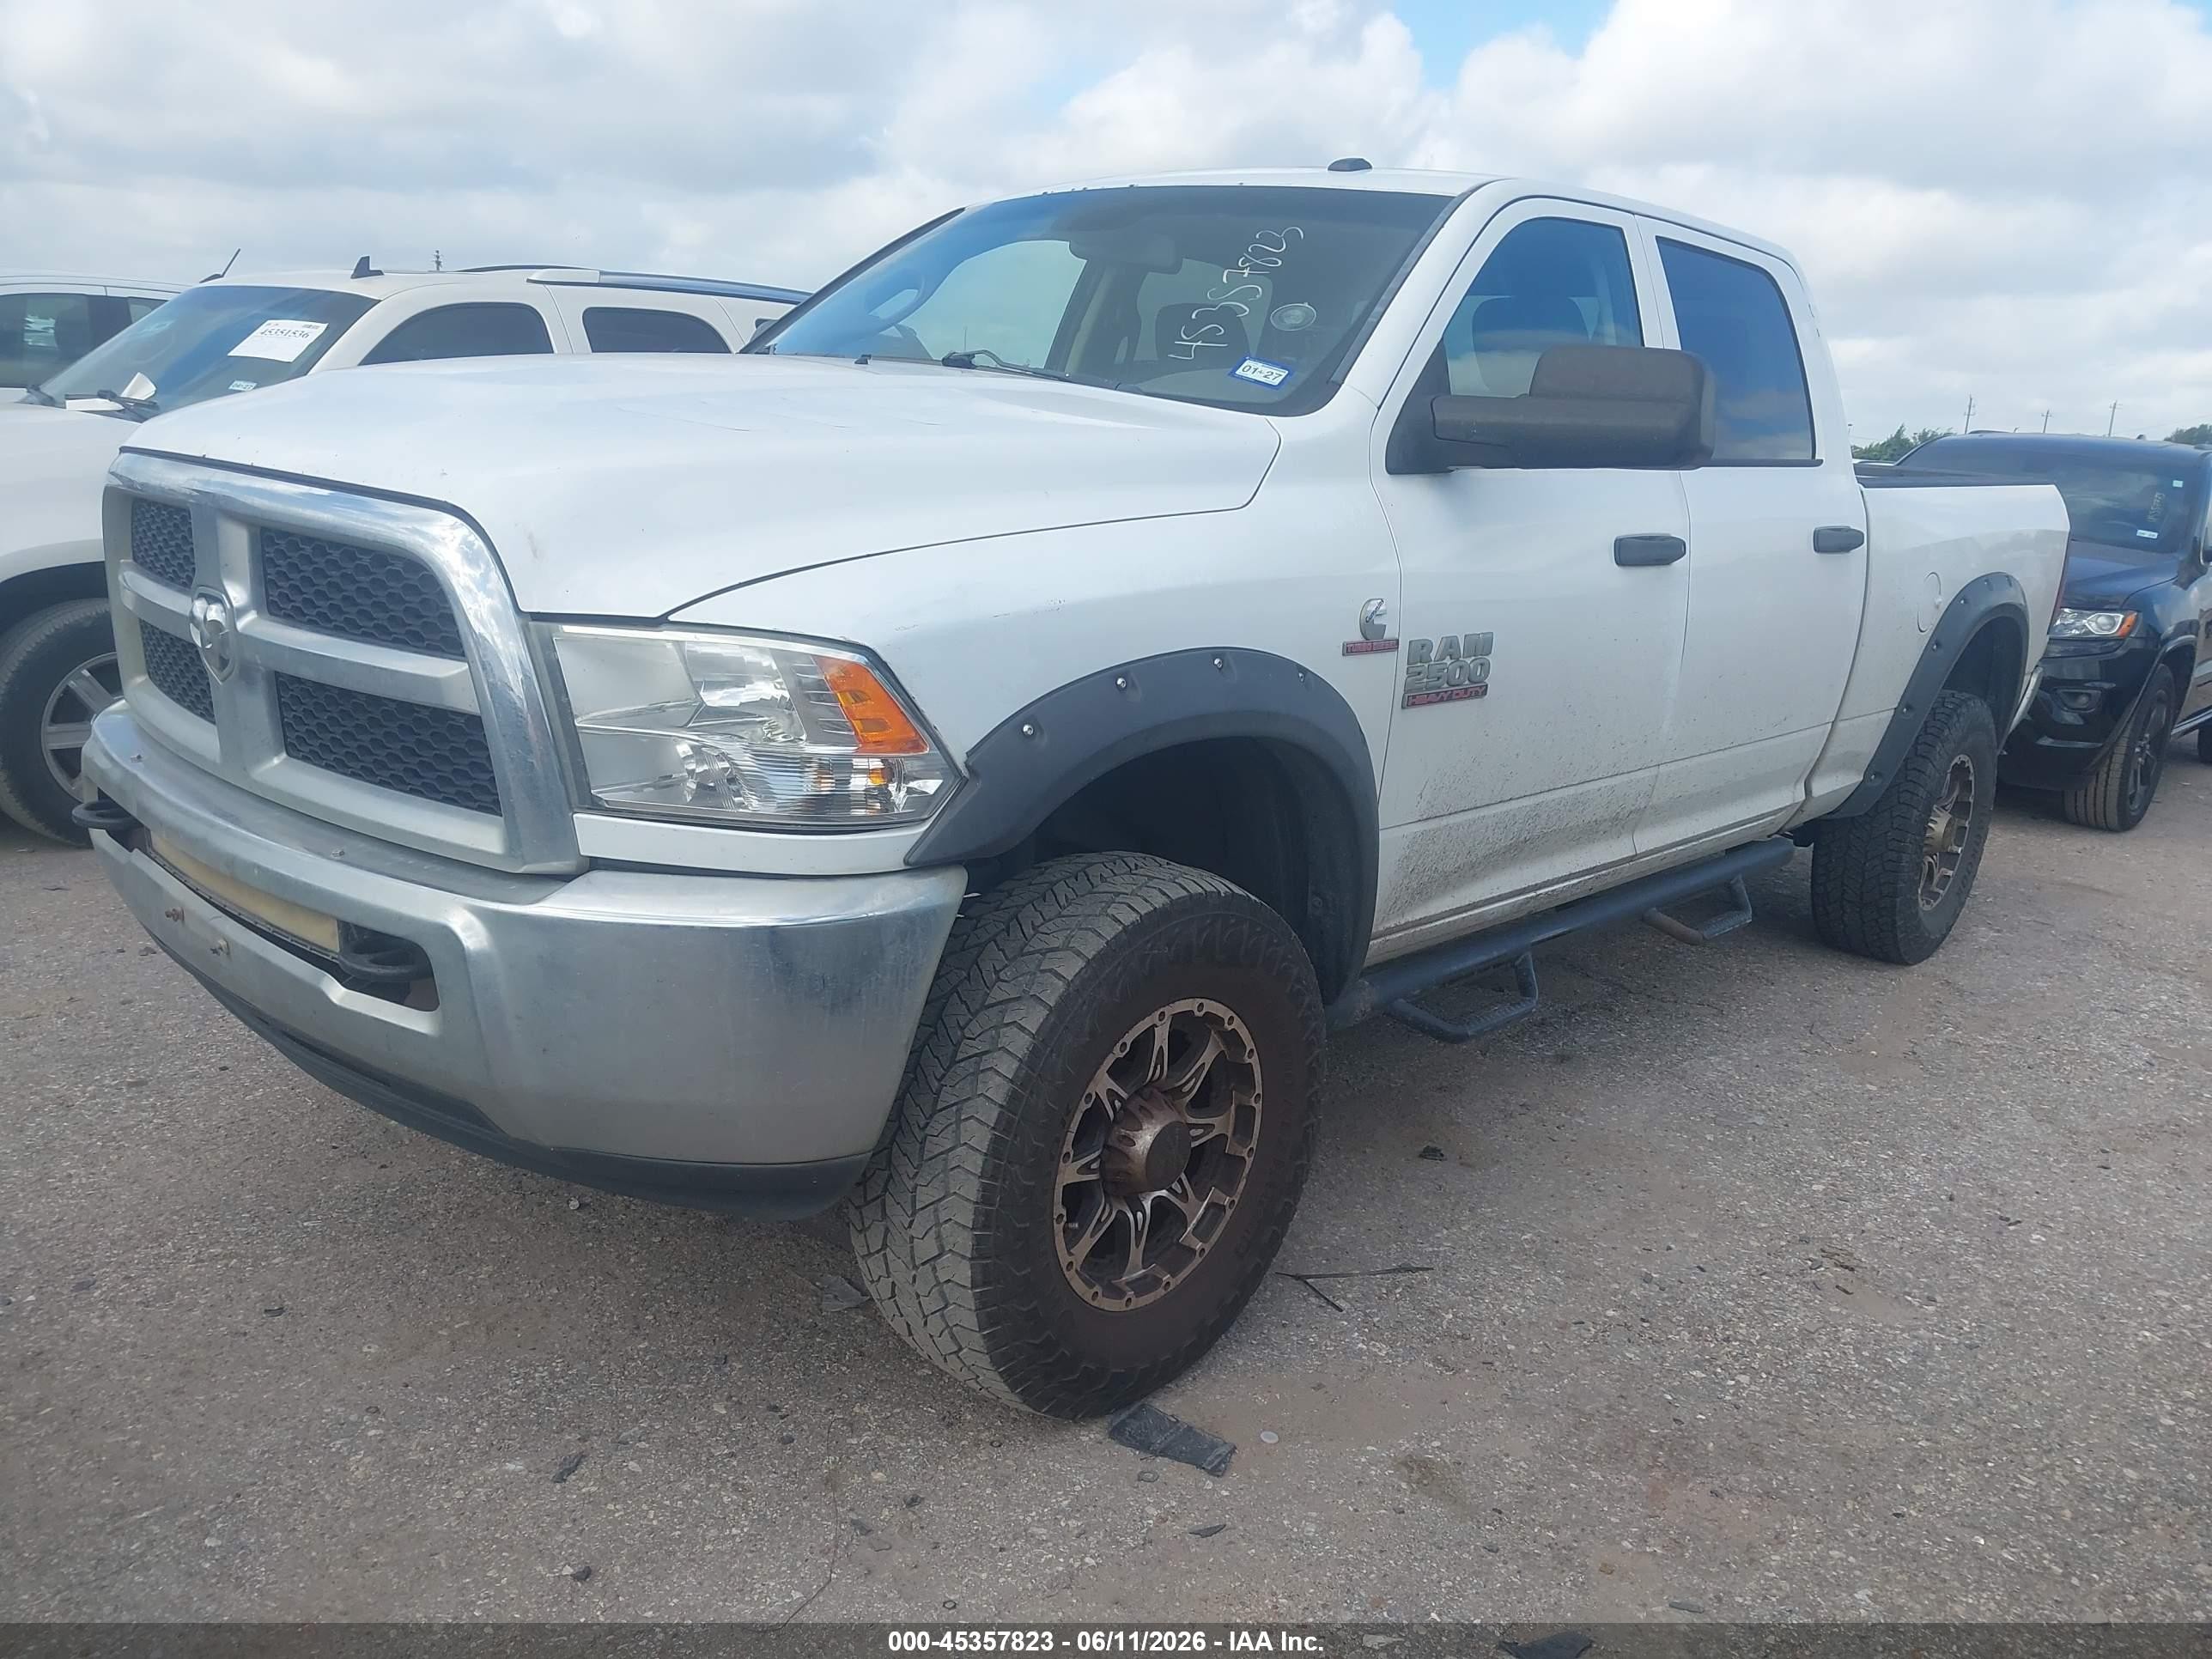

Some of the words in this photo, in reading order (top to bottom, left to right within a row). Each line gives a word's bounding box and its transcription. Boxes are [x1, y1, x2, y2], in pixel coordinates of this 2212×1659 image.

[1167, 226, 1304, 360] 45357823
[259, 328, 310, 339] 45351536
[1407, 631, 1494, 665] RAM
[1403, 657, 1492, 694] 2500
[1407, 690, 1452, 706] HEAVY
[1453, 686, 1485, 700] DUTY
